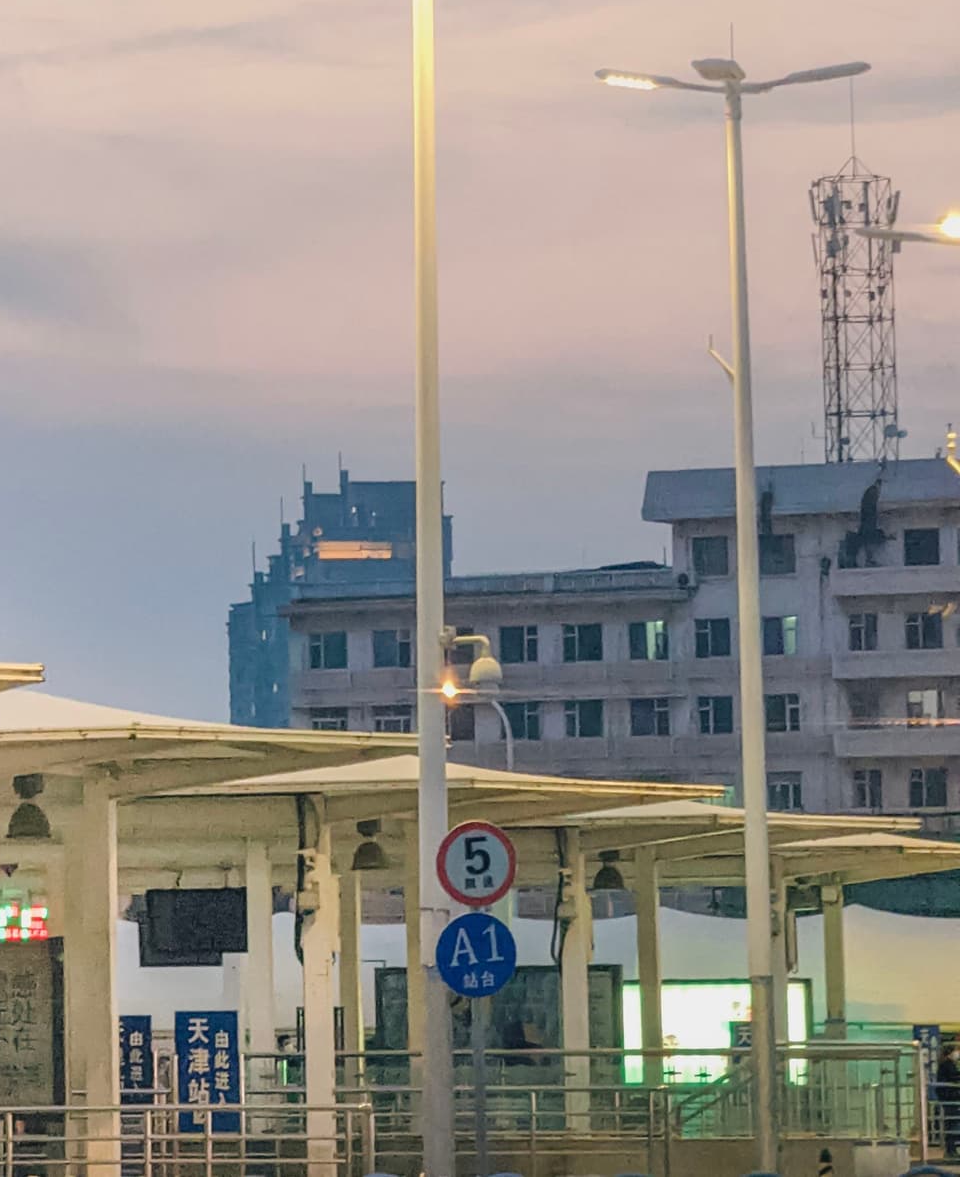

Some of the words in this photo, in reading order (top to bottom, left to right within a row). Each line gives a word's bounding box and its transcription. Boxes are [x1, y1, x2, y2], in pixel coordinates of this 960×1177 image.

[464, 836, 491, 875] 5
[449, 923, 505, 967] A1
[463, 971, 495, 989] 站台
[187, 1018, 210, 1105] 天津站
